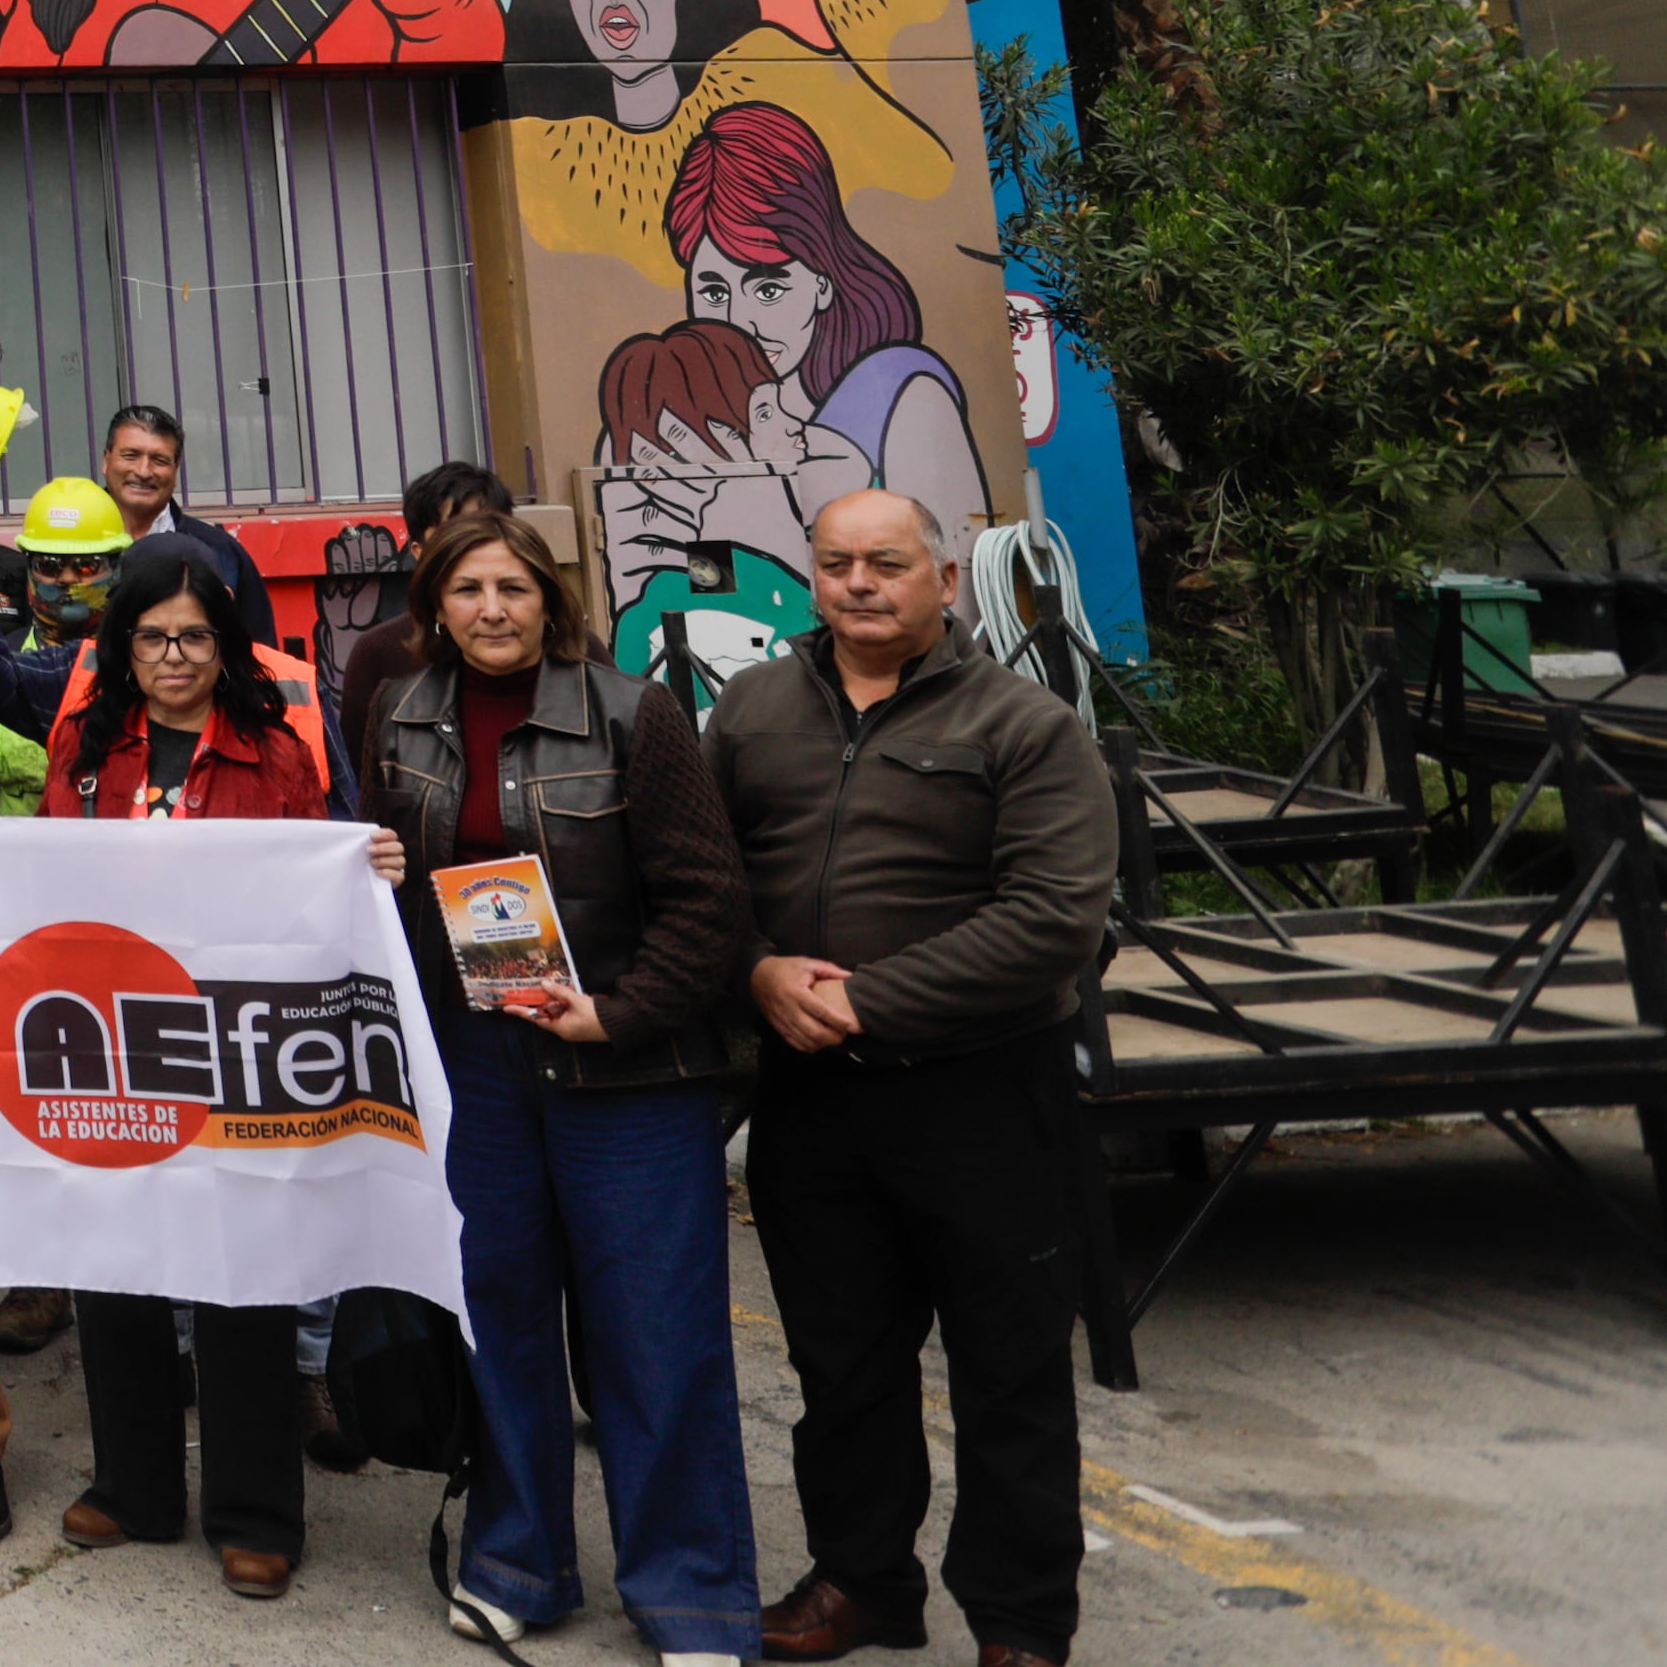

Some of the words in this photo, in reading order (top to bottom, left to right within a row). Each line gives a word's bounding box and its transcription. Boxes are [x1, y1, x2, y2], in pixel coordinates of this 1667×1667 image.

[359, 983, 387, 998] POR
[353, 997, 400, 1020] PÚBLIC
[37, 1100, 151, 1122] ASISTENTES
[154, 1105, 178, 1125] DE
[224, 1114, 338, 1140] FEDERACIÓN
[340, 1105, 420, 1141] NACIONAL
[37, 1119, 62, 1139] LA
[66, 1122, 179, 1145] EDUCACION
